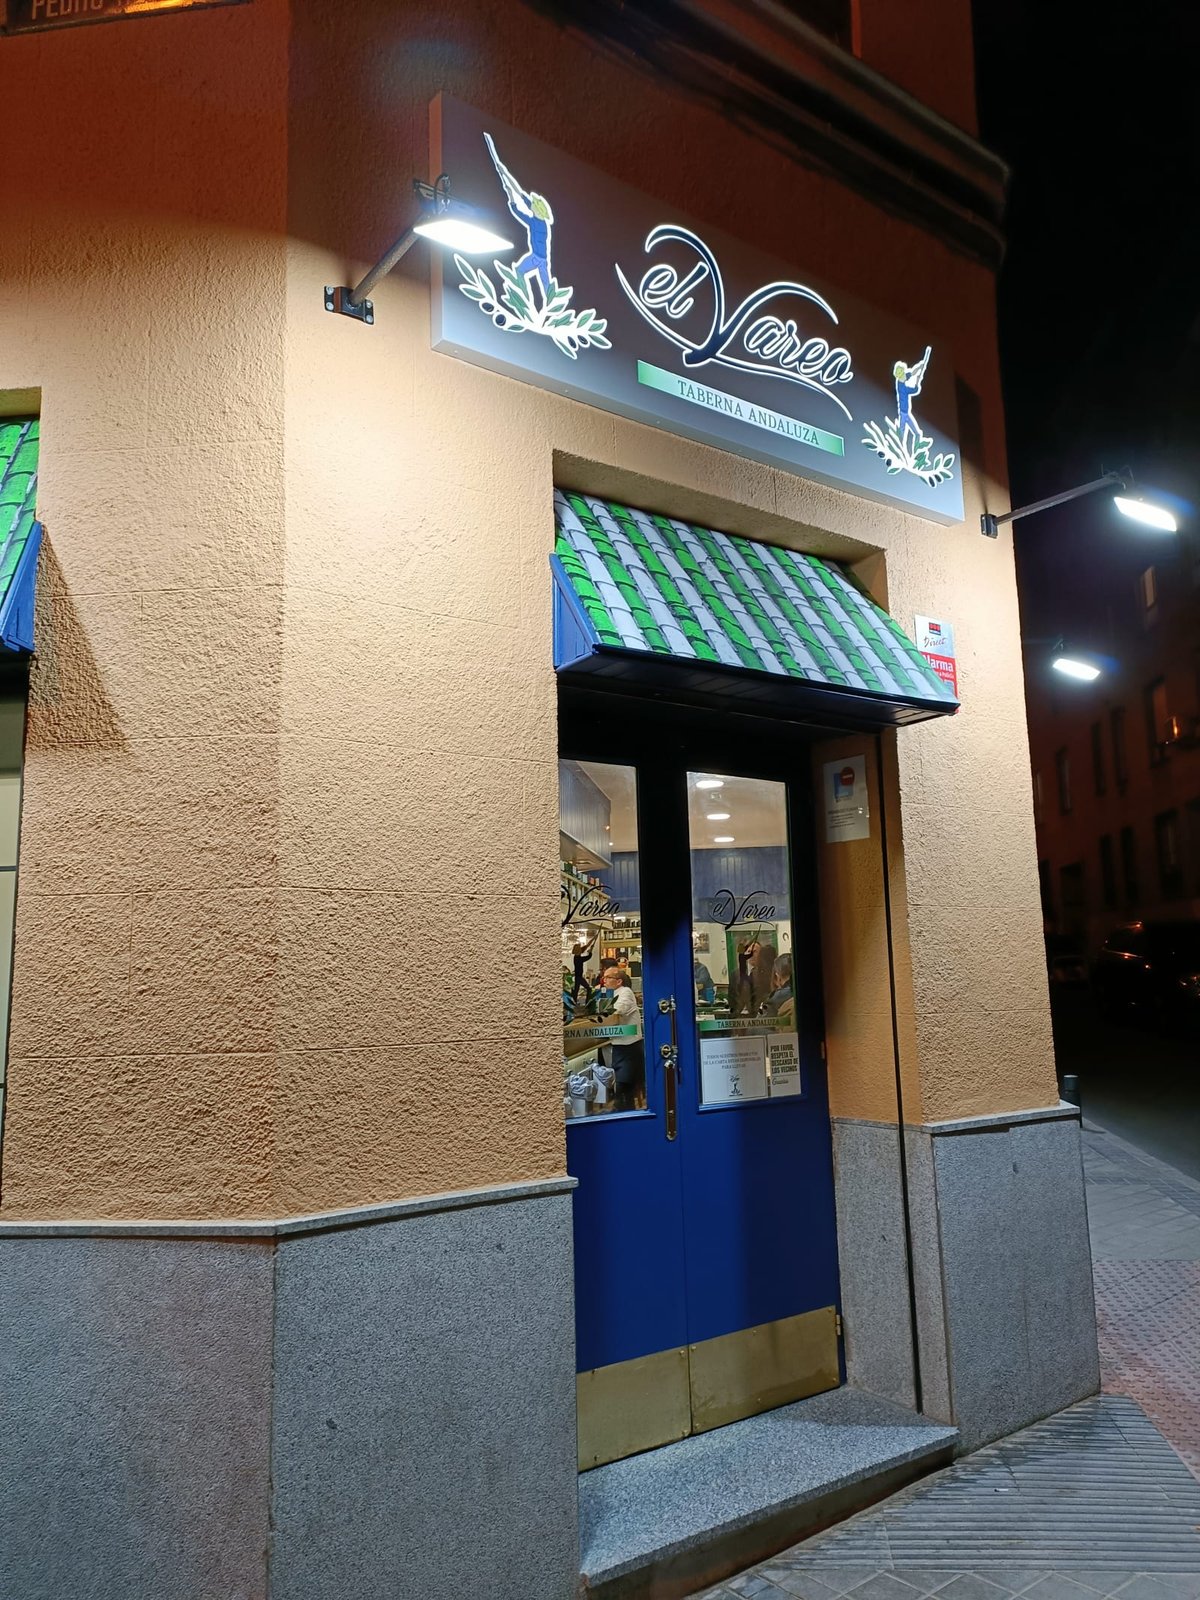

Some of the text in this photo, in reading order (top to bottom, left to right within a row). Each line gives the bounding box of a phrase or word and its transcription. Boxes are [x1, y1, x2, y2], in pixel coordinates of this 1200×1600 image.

[635, 224, 855, 386] el Vareo
[677, 379, 820, 445] TABERNA ANDALUZA
[712, 889, 776, 930] el Vareo
[583, 1027, 624, 1038] ANDALUZA
[717, 1019, 746, 1029] TABERNA
